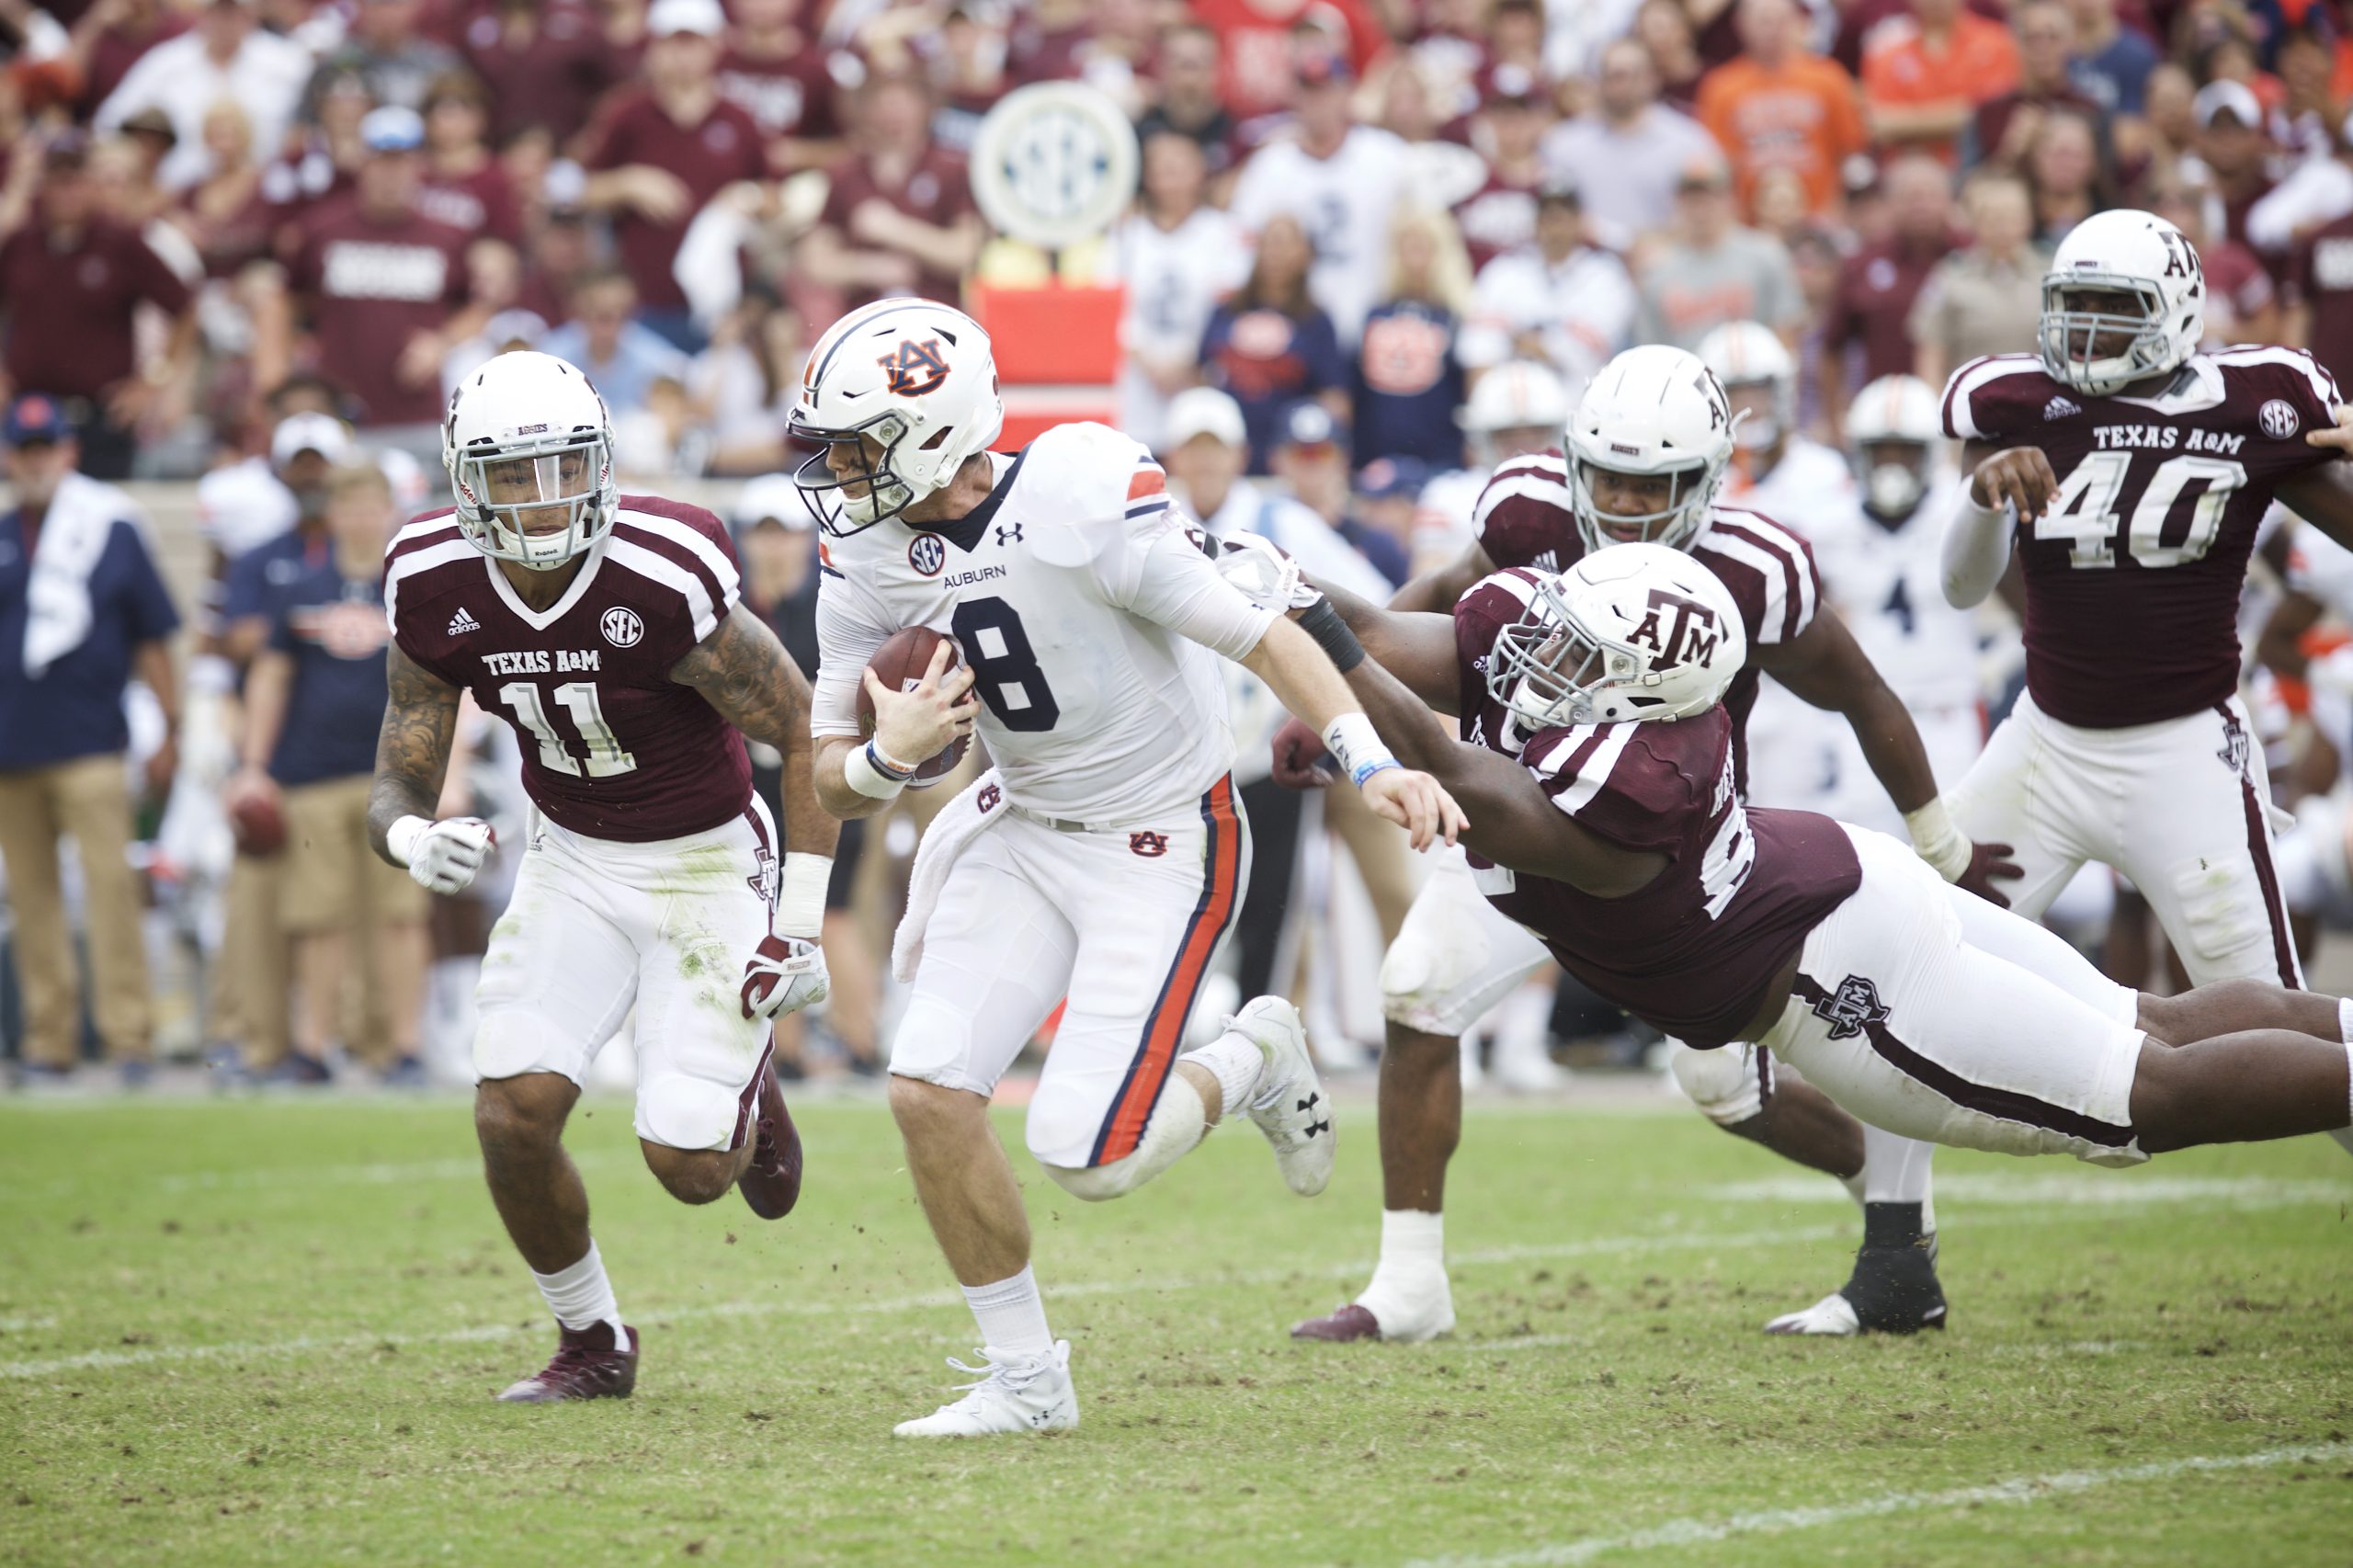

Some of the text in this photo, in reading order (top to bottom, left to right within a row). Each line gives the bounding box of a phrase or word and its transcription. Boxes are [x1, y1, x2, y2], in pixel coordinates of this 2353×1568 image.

[2263, 402, 2296, 437] SEC
[2093, 425, 2245, 455] TEXAS A&M
[2034, 450, 2248, 569] 40
[910, 536, 944, 575] SEC
[943, 564, 1007, 590] AUBURN
[1882, 573, 1914, 634] 4
[448, 620, 481, 636] adidas
[604, 609, 641, 644] SEC
[481, 650, 600, 676] TEXAS A&M
[950, 597, 1060, 733] 8
[498, 682, 638, 778] 11
